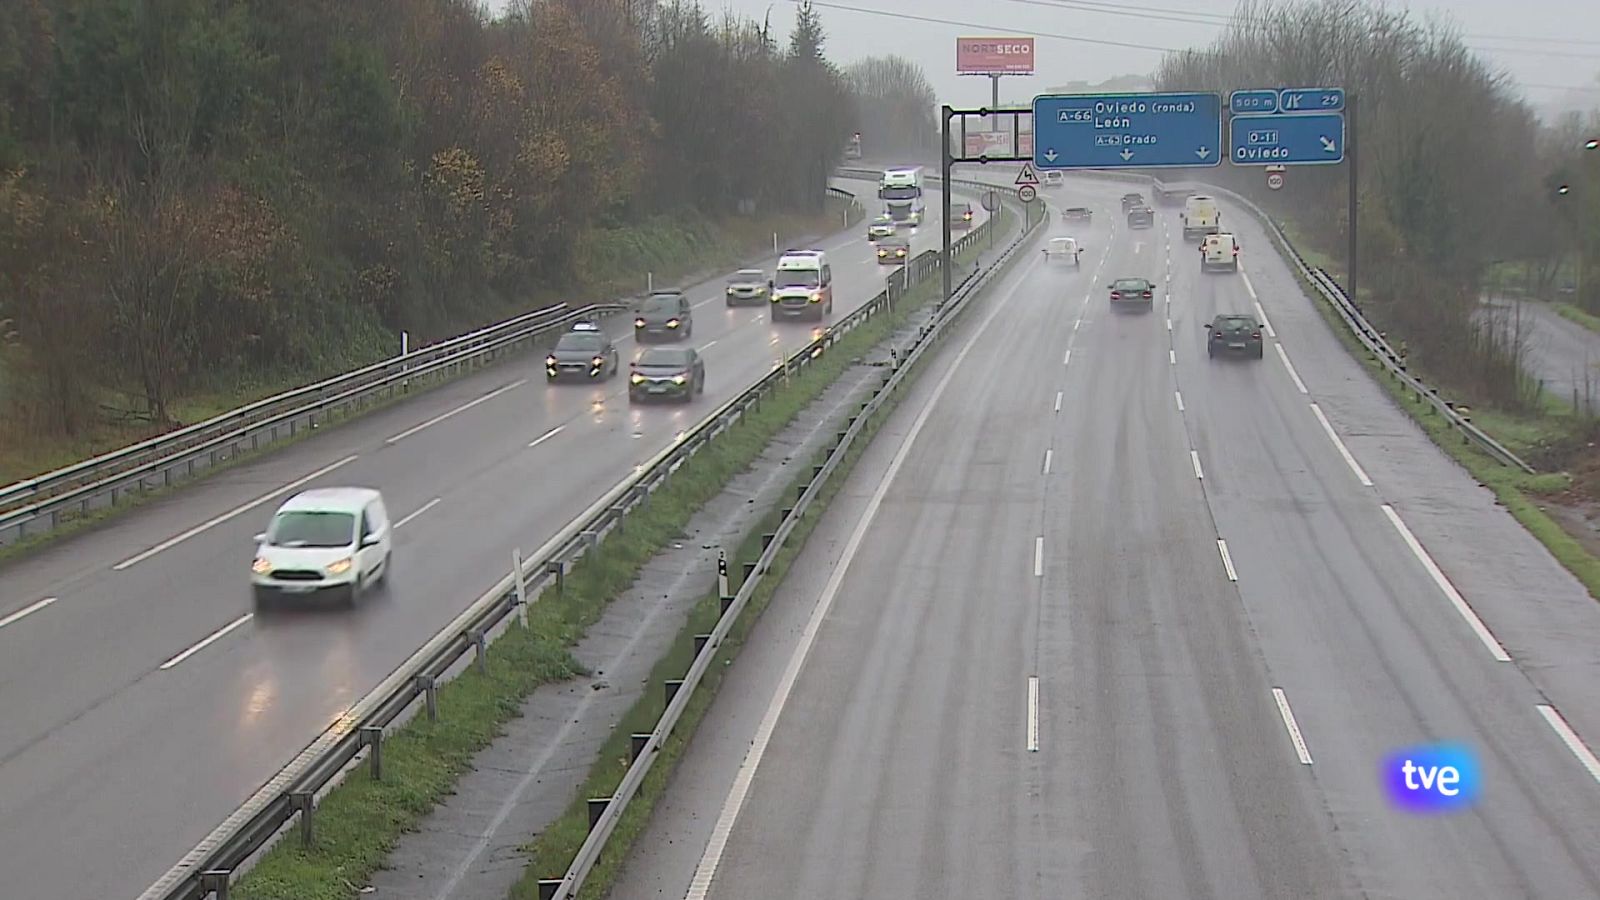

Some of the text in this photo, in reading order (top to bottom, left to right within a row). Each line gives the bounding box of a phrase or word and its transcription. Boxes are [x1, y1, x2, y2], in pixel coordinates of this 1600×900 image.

[1236, 98, 1258, 107] 500
[1321, 95, 1339, 105] 29
[1095, 102, 1195, 114] Oviedo (ronda)
[1059, 112, 1091, 121] A-66
[1095, 117, 1130, 128] León
[1123, 135, 1157, 144] Grado
[1237, 147, 1288, 159] Oviedo
